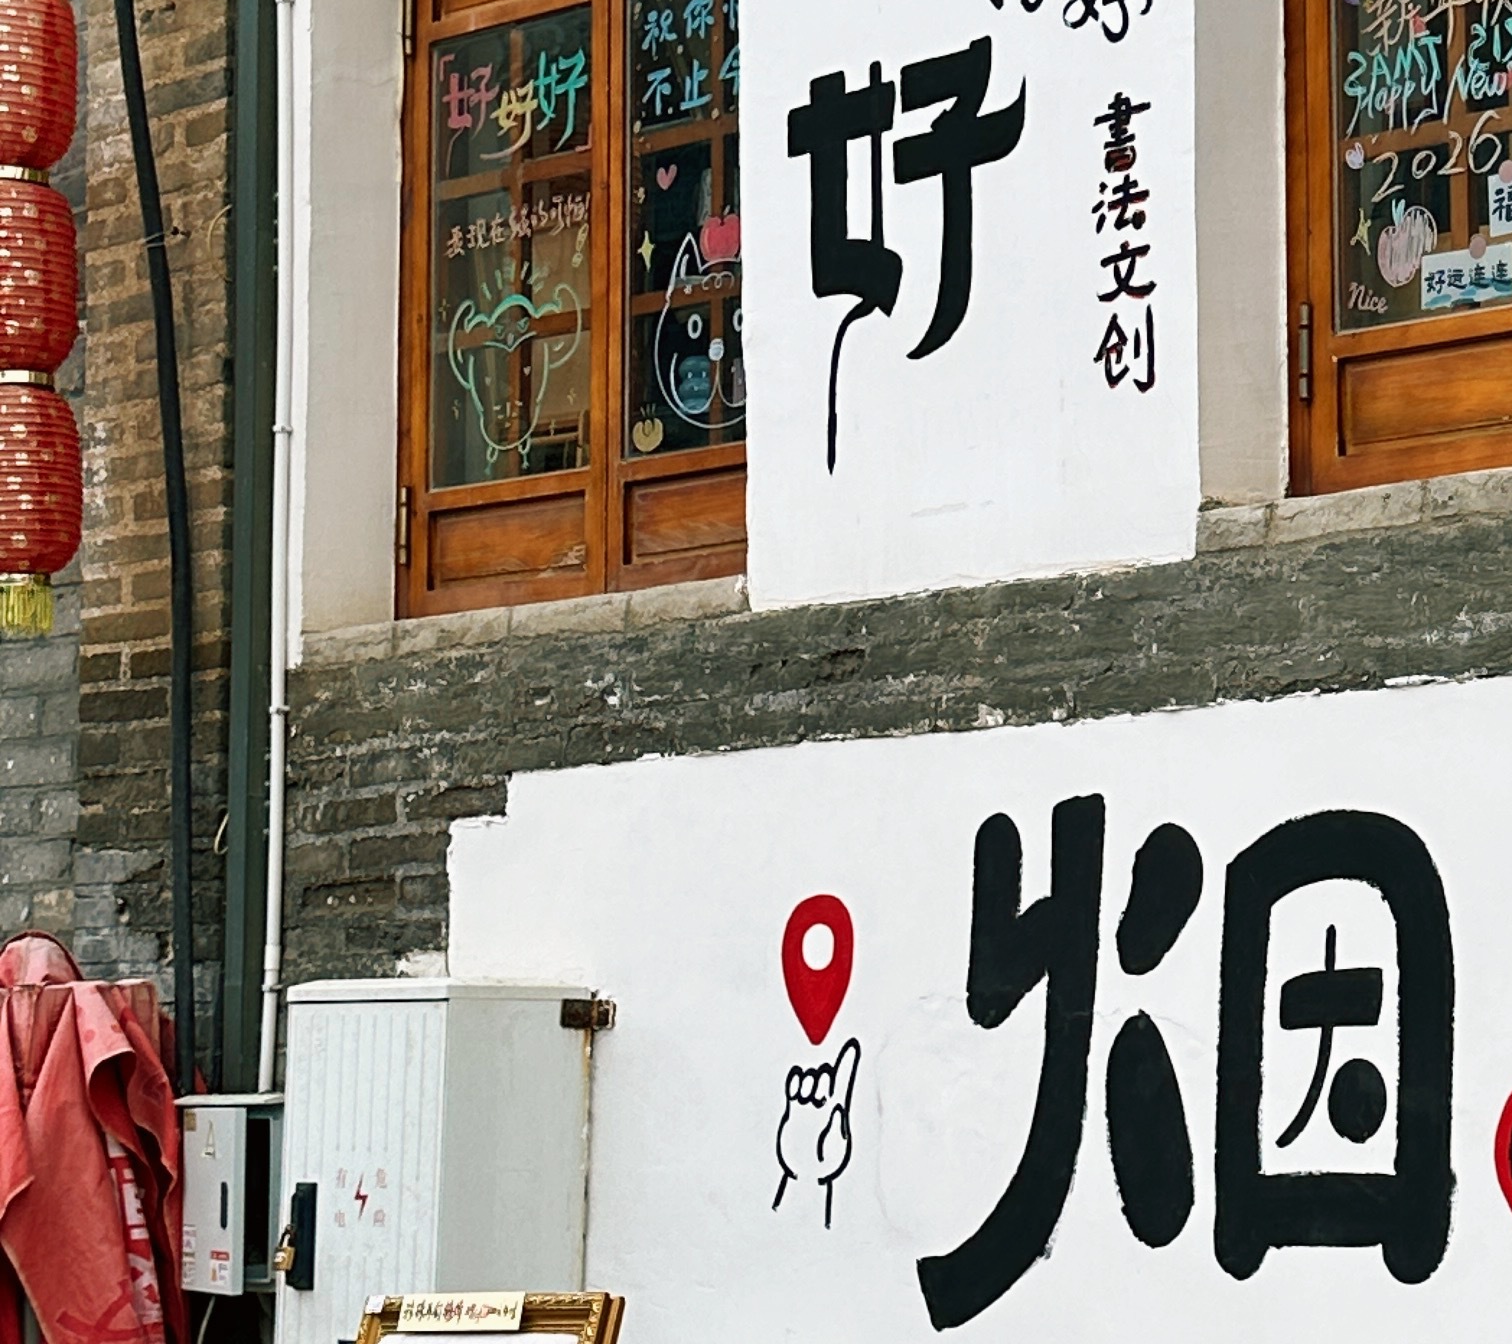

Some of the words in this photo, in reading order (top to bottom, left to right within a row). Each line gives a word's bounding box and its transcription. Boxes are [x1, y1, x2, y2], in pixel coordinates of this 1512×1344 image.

[1344, 71, 1441, 140] Happy
[1443, 54, 1510, 124] New
[1370, 109, 1503, 203] 2026
[1348, 282, 1389, 314] Nice
[915, 793, 1457, 1333] 烟
